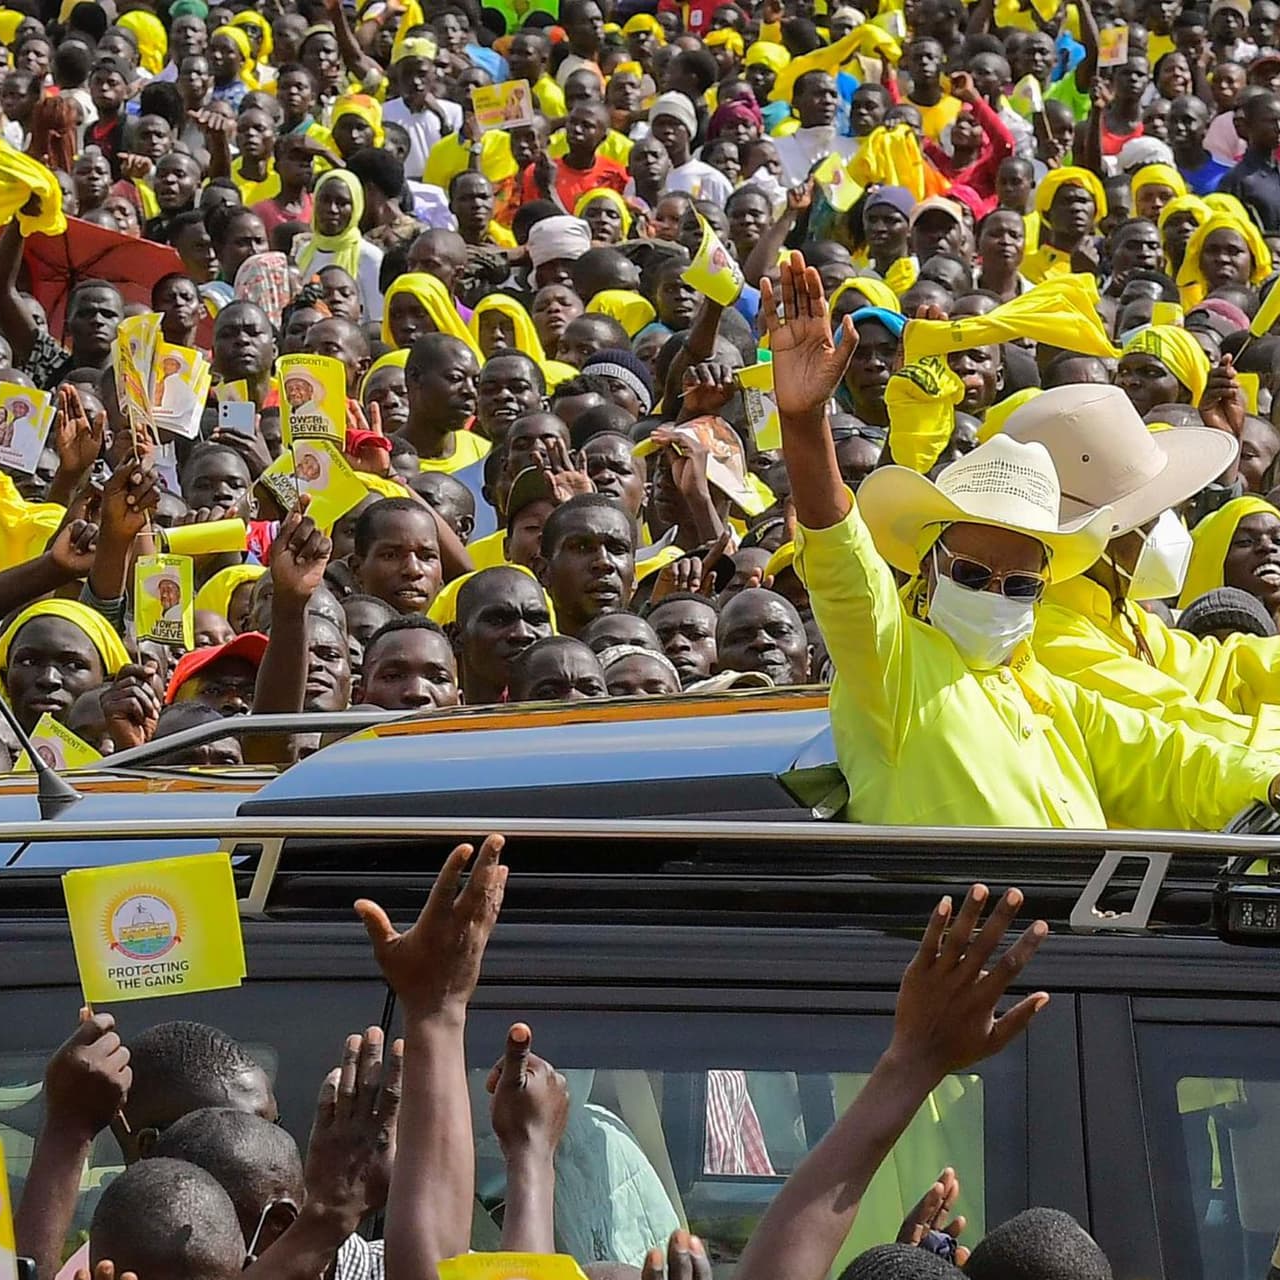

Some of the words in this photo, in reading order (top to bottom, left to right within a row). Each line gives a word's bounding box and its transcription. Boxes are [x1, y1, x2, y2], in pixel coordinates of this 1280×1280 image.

[282, 358, 321, 368] PRESIDENT
[49, 724, 81, 750] PRESIDENT
[108, 961, 190, 979] PROTECTING
[116, 975, 141, 990] THE
[144, 974, 184, 987] GAINS
